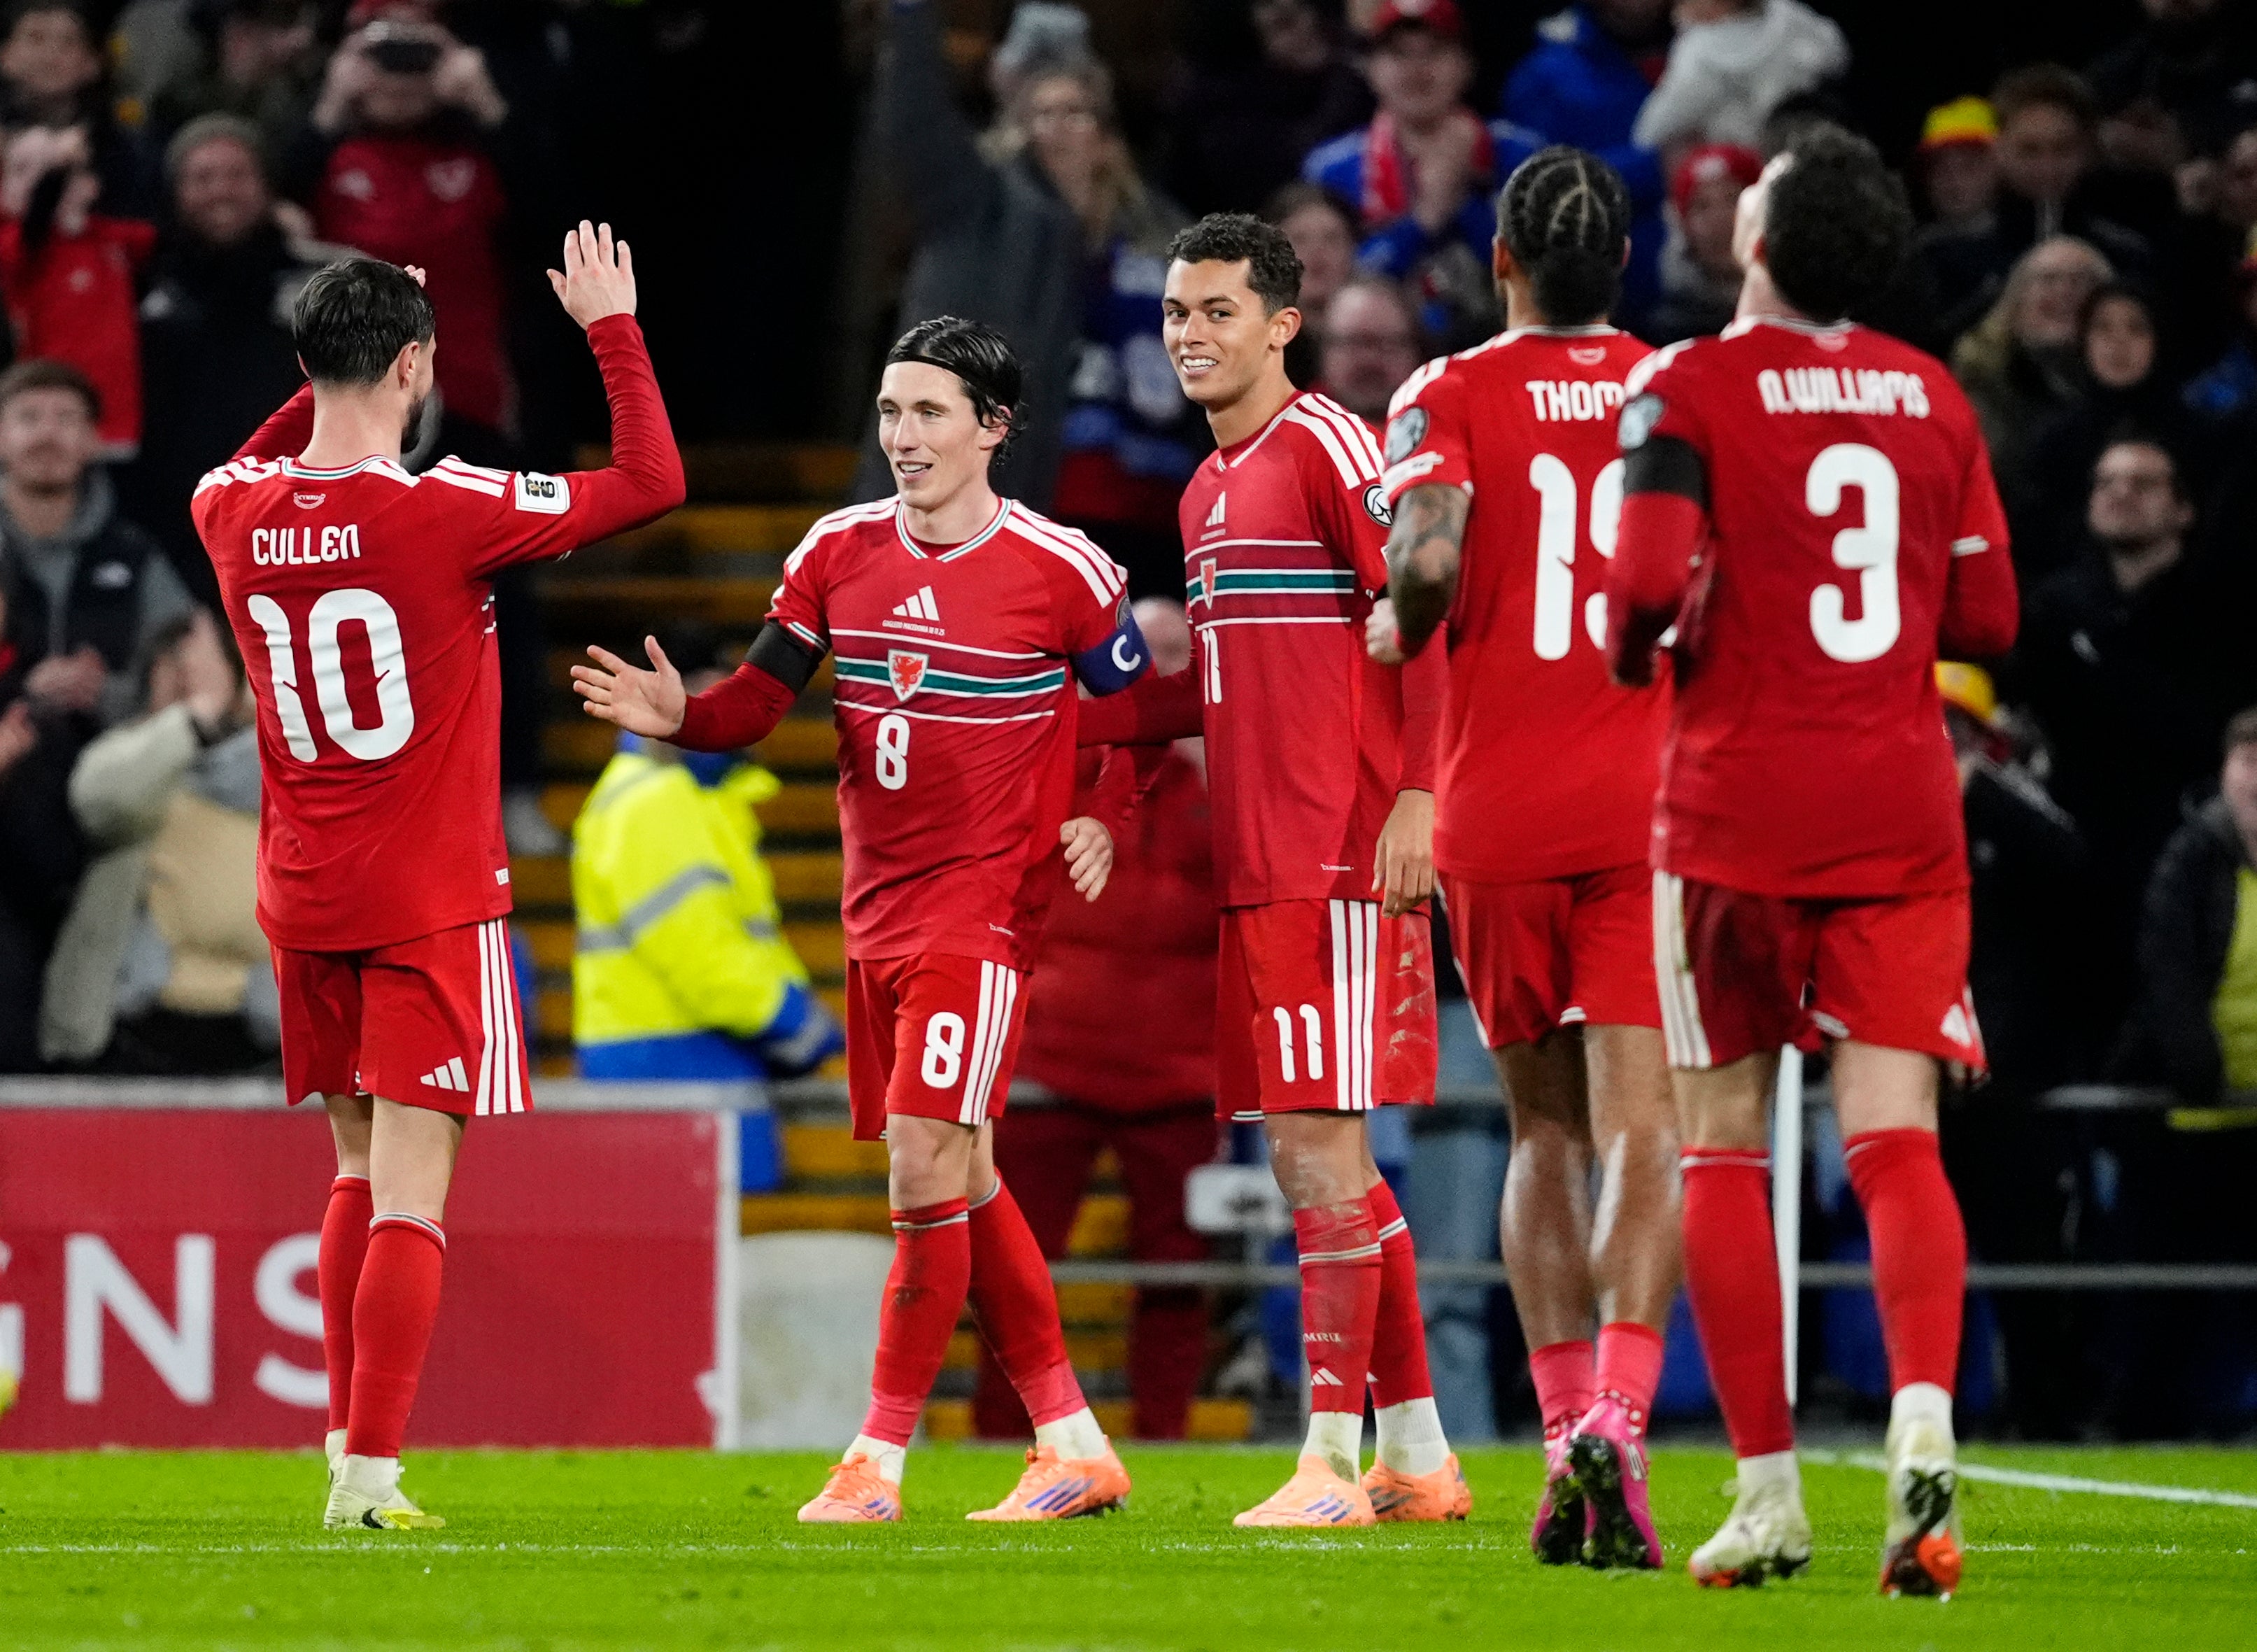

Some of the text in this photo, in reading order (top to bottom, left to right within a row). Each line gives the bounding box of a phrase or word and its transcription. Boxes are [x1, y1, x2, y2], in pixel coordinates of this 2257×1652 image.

[1757, 367, 1930, 419] N.WILLIAMS
[252, 523, 361, 565] CULLEN
[1806, 442, 1902, 663] 3
[248, 588, 414, 763] 10
[1111, 634, 1141, 672] C
[875, 714, 911, 791] 8
[921, 1011, 966, 1089] 8
[1273, 1003, 1324, 1084] 11
[0, 1232, 330, 1408] NS
